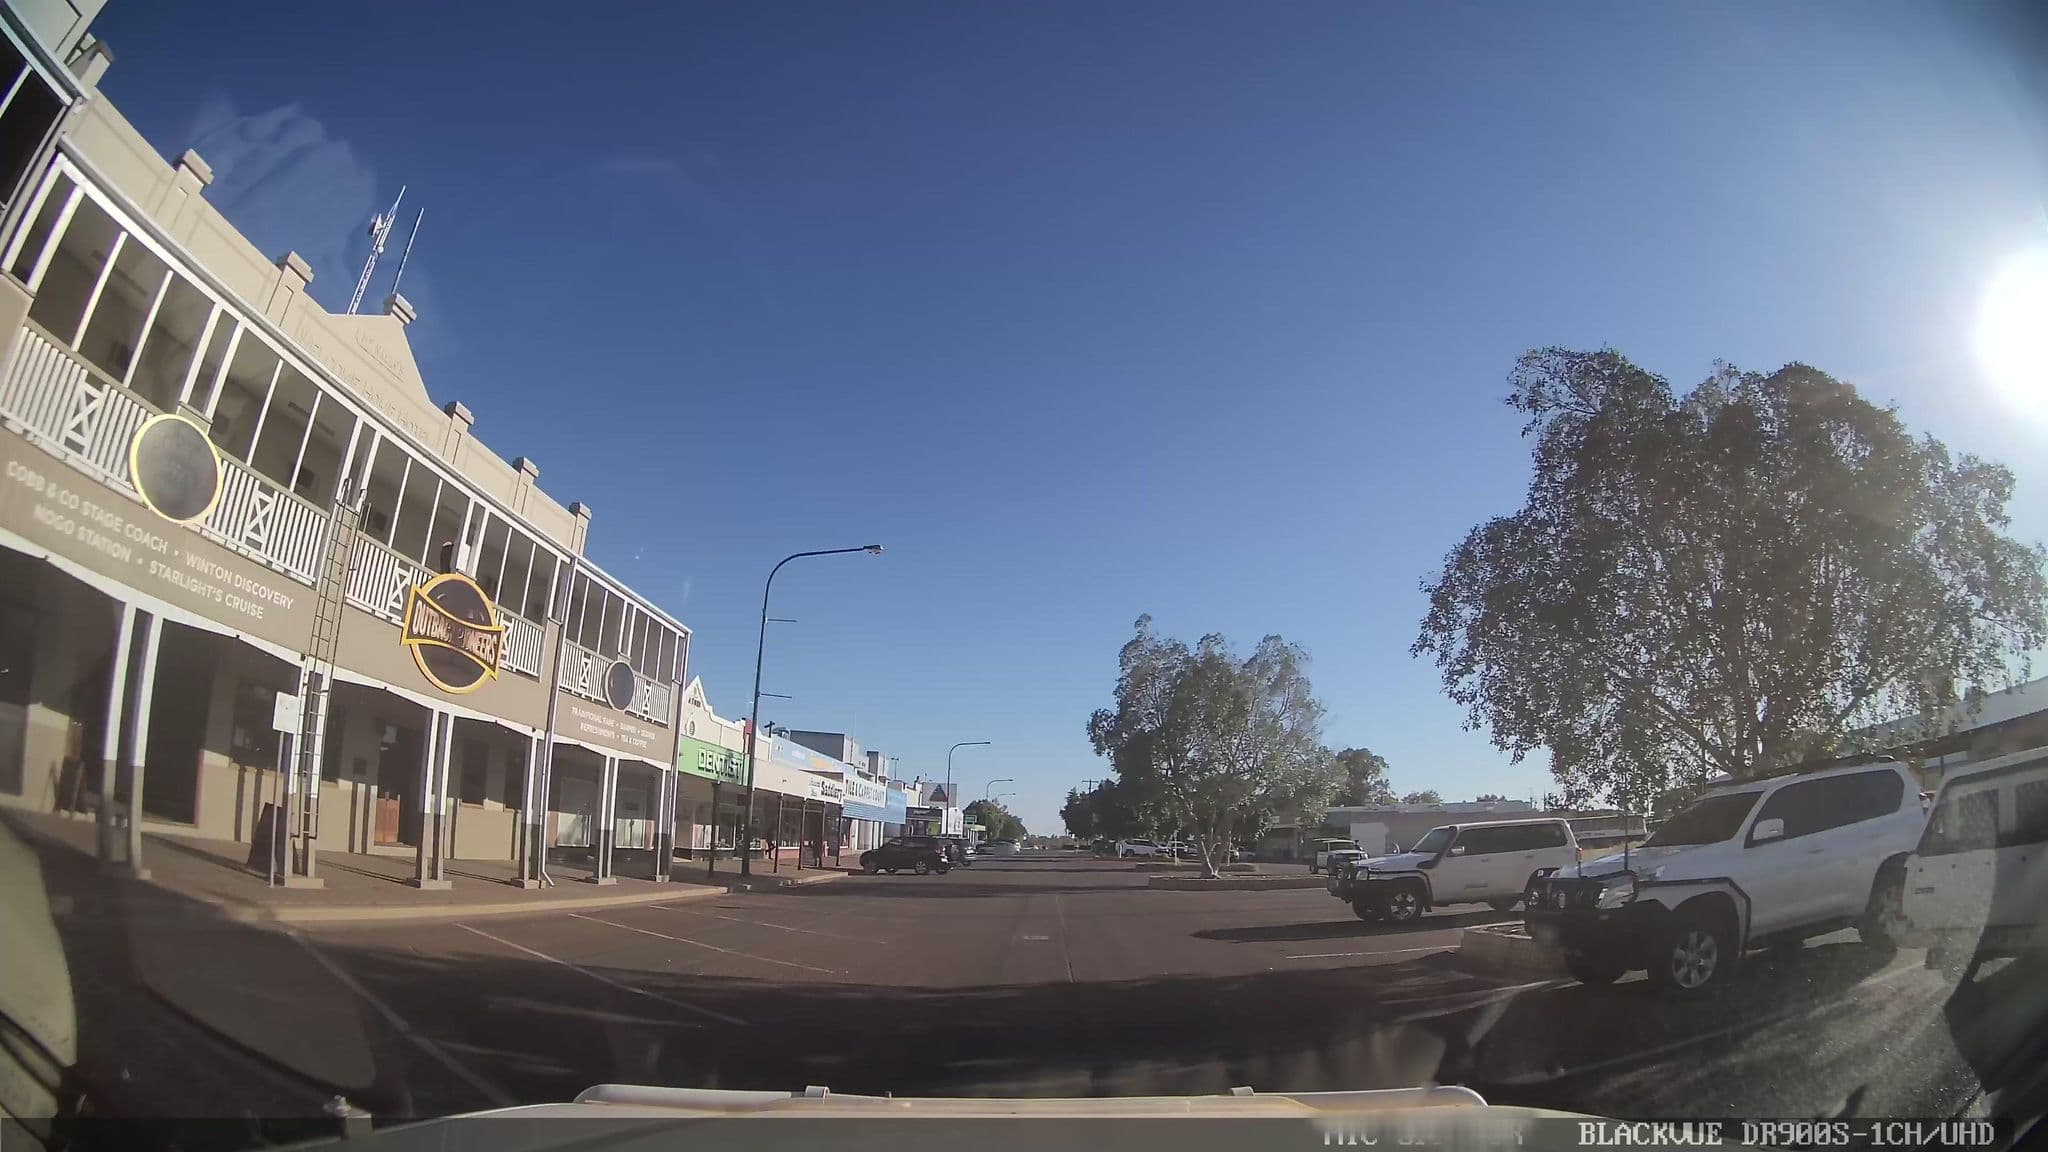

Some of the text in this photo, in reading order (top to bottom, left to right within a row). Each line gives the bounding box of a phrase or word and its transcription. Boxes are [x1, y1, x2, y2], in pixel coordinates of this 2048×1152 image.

[7, 460, 44, 493] COBB
[59, 489, 80, 510] CO
[82, 500, 122, 532] STAGE
[124, 522, 168, 554] COACH
[186, 551, 233, 584] WINTON
[235, 575, 294, 611] DISCOVERY
[77, 526, 131, 563] STATION
[149, 560, 223, 604] STARLIGHT'S
[225, 591, 264, 620] CRUISE
[699, 748, 743, 778] DENTIST
[821, 781, 843, 803] Saddlery
